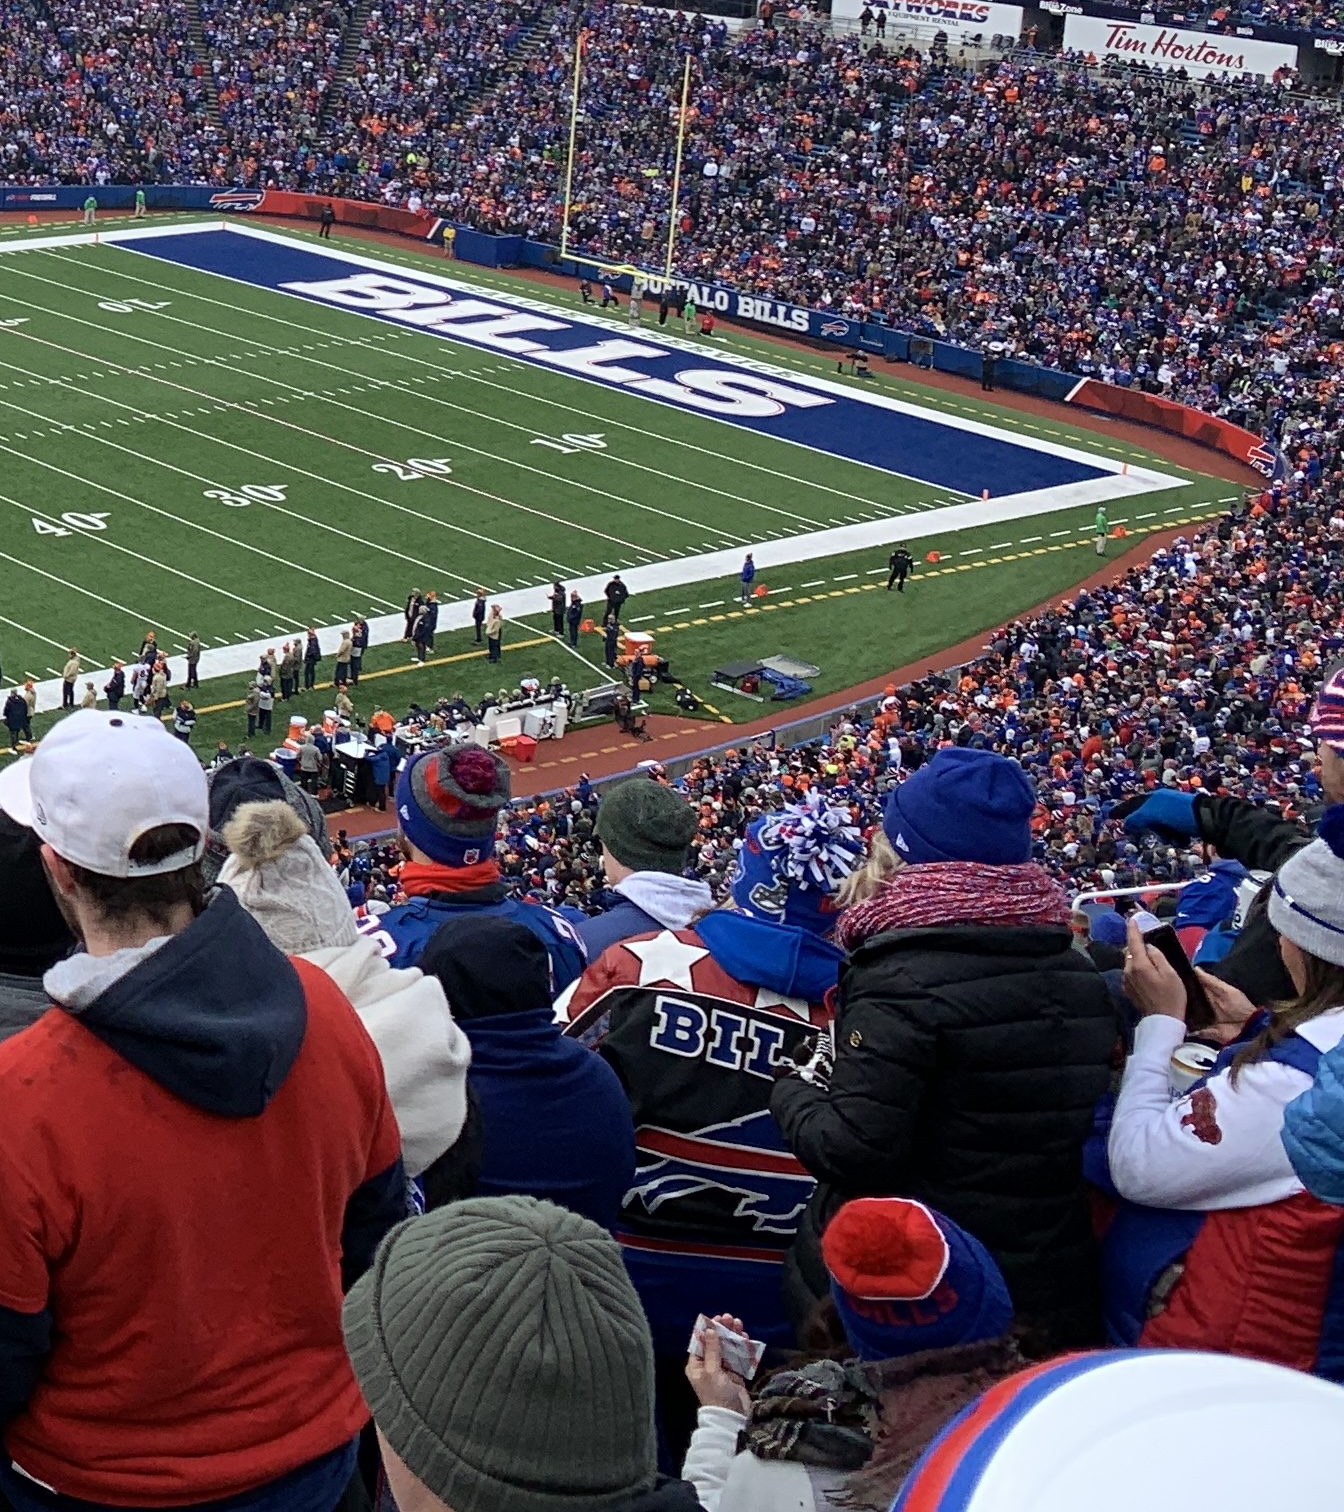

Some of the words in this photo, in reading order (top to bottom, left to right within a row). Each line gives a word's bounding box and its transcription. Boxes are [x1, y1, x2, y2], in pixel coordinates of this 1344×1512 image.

[888, 11, 930, 23] EQUIPMENT
[932, 17, 960, 27] RENTAL
[1107, 24, 1147, 55] Tim
[1151, 29, 1246, 70] Hortons
[98, 297, 165, 313] 10
[737, 295, 810, 332] BILLS
[279, 273, 836, 418] BILLS
[458, 285, 589, 324] SALUTE
[642, 331, 801, 379] SERVICE
[530, 433, 605, 455] 10
[372, 457, 450, 481] 20
[203, 484, 283, 507] 30
[31, 510, 105, 538] 40
[649, 995, 792, 1082] BIL
